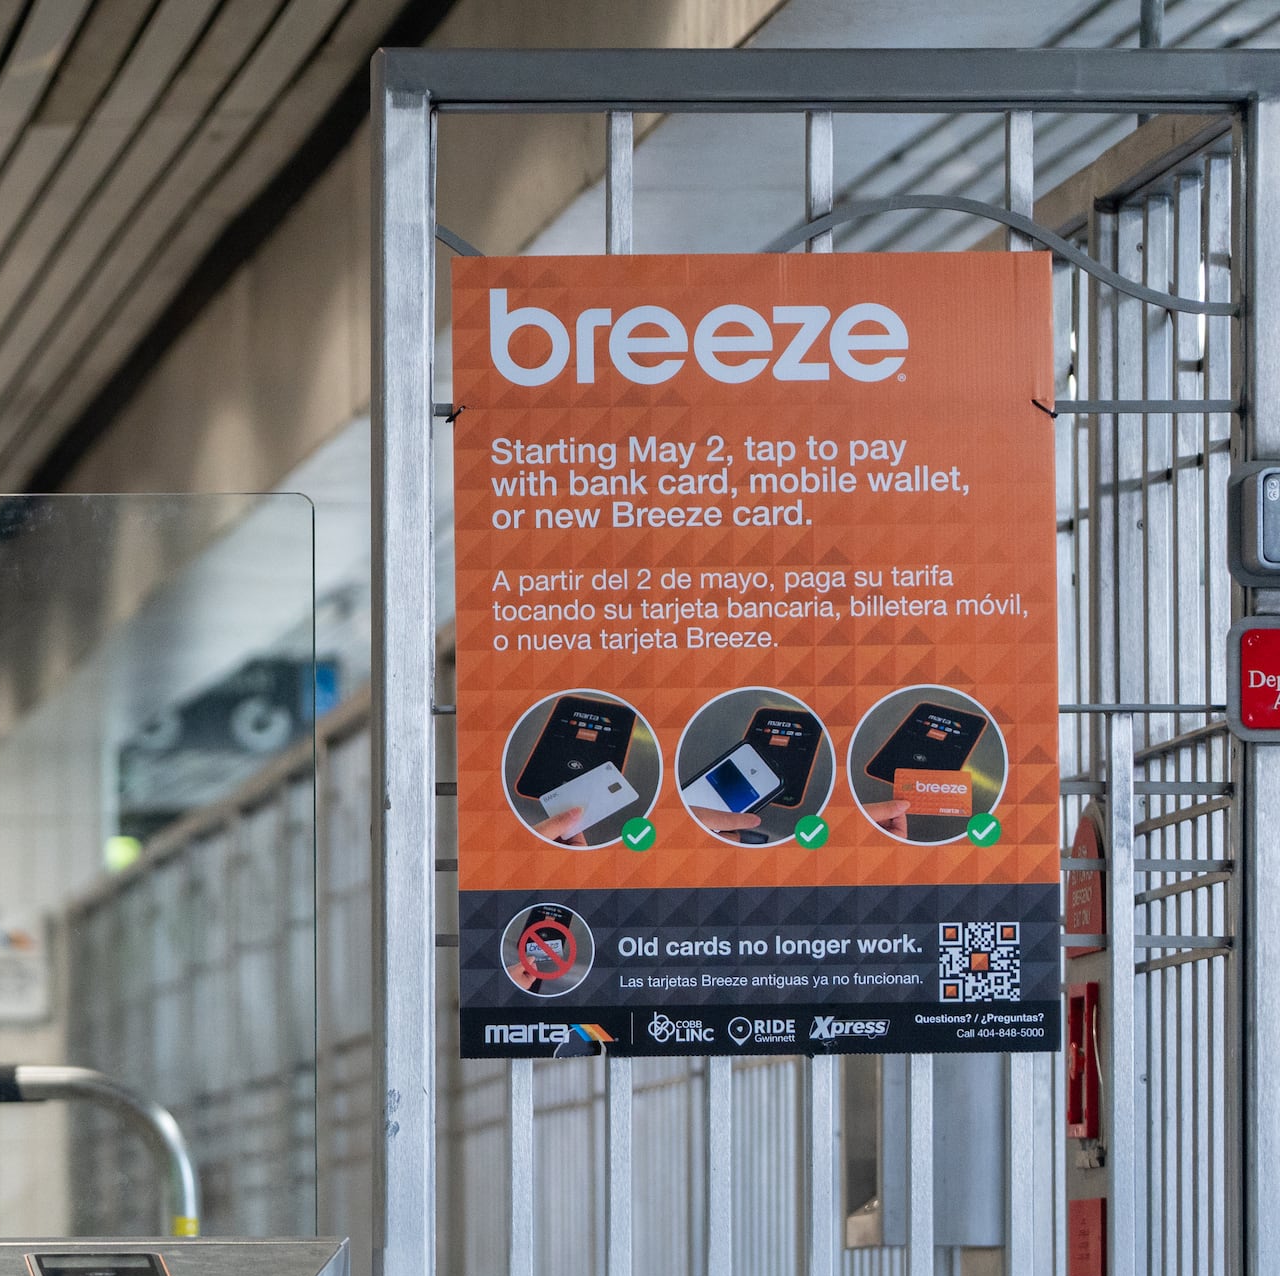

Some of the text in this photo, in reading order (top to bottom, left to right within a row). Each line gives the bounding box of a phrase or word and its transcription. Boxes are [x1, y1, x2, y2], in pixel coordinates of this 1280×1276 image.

[490, 289, 909, 386] breeze
[492, 436, 906, 470] Starting May 2, tap to pay
[492, 462, 968, 498] with bank card, mobile wallet,
[492, 499, 812, 529] or new Breeze card.
[492, 565, 953, 596] A partir del 2 de mayo, paga su tarifa
[493, 594, 1027, 624] tocando su tarjeta bancaria, billetera móvil,
[494, 627, 777, 654] o nueva tarjeta Breeze.
[573, 711, 600, 722] marta
[916, 780, 968, 794] breeze
[619, 934, 922, 958] Old cards no longer work.
[621, 973, 923, 990] Las tarjetas Breeze antiguas ya no funcionan.
[755, 1020, 795, 1033] RIDE
[810, 1016, 886, 1040] Xpress
[915, 1014, 971, 1023] Questions?
[981, 1013, 1044, 1024] ¿Preguntas?
[484, 1022, 570, 1044] marta
[676, 1028, 714, 1041] LINC
[755, 1034, 795, 1042] Gwinnett
[957, 1028, 1044, 1038] Call 404-848-5000
